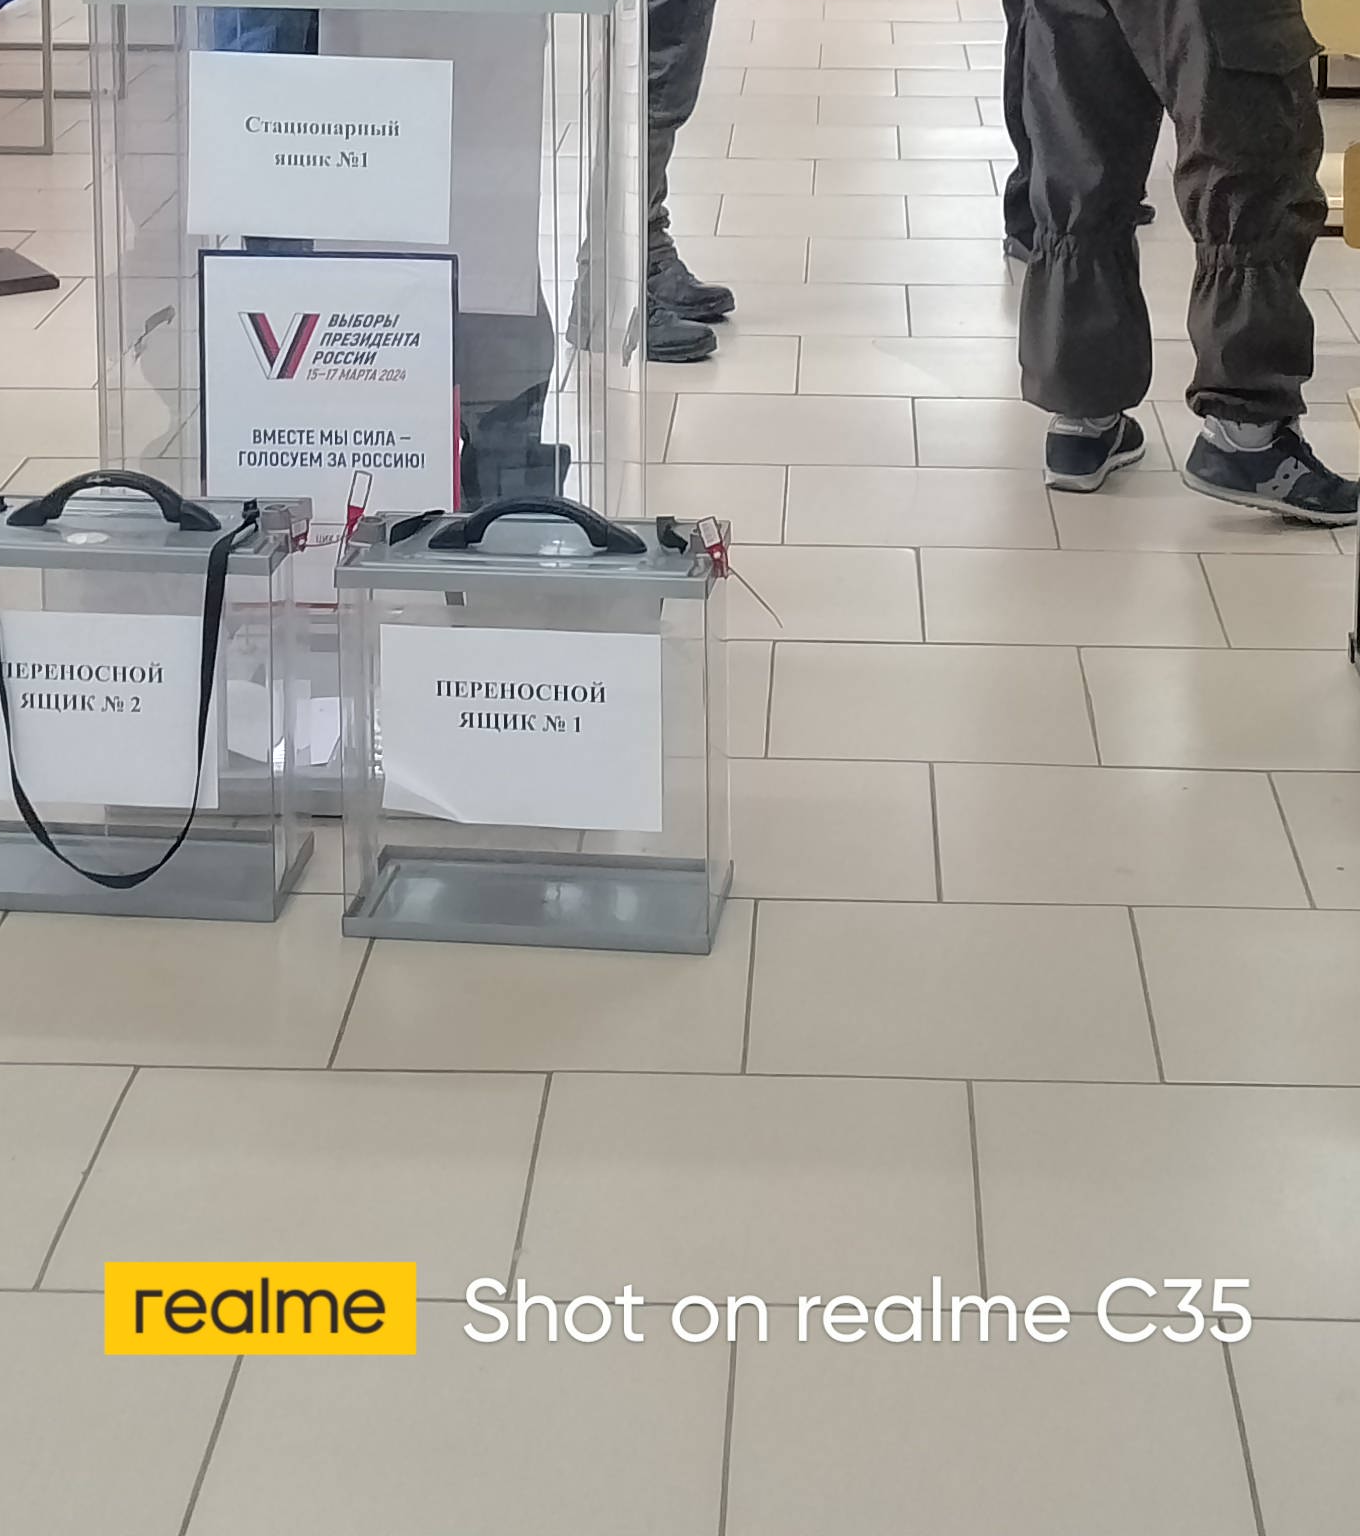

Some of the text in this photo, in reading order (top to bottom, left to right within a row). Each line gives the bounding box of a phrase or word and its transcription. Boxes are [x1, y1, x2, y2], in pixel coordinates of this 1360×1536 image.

[245, 115, 400, 140] Стационарный
[274, 153, 332, 168] ящик
[328, 313, 400, 328] ВЫБОРЫ
[320, 332, 420, 349] ПРЕЗИДЕНТА
[312, 351, 377, 365] РОССИИ
[339, 368, 376, 381] МАРТА
[378, 369, 406, 382] 2024
[252, 429, 315, 445] ВМЕСТЕ
[320, 430, 348, 446] МЫ
[353, 430, 396, 446] СИЛА
[239, 450, 425, 468] ГОЛОСУЕМ ЗА РОССИЮ!
[436, 680, 606, 703] ПЕРЕНОСНОЙ
[20, 692, 141, 712] ЯЩИК № 2
[458, 712, 582, 732] ЯЩИК № 1
